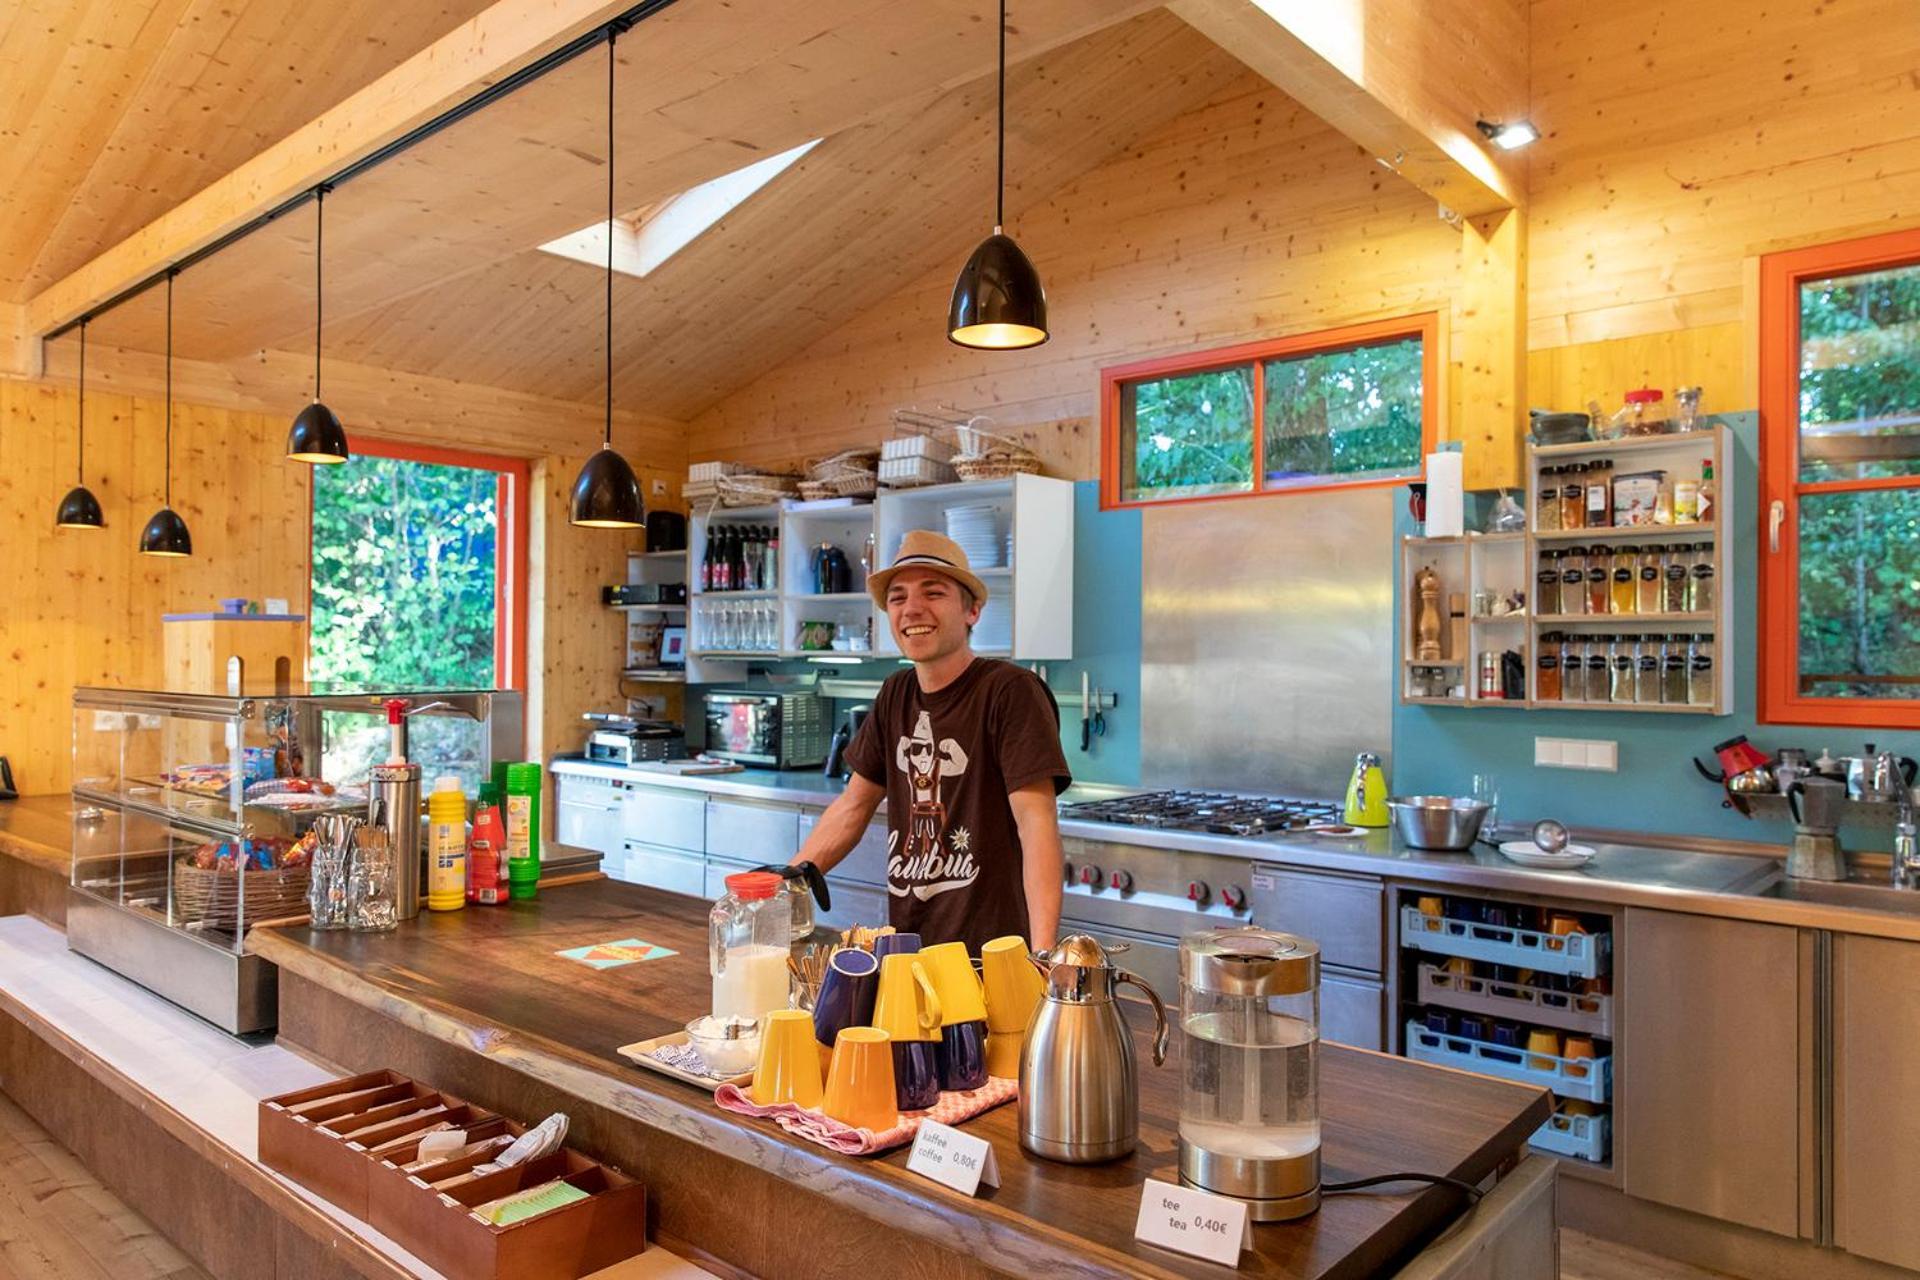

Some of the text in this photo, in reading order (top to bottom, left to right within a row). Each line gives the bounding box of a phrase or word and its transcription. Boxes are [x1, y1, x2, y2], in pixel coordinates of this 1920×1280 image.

[922, 1129, 948, 1148] kaffee
[918, 1147, 943, 1164] coffee
[1162, 1198, 1180, 1212] tee
[1169, 1217, 1187, 1231] tea
